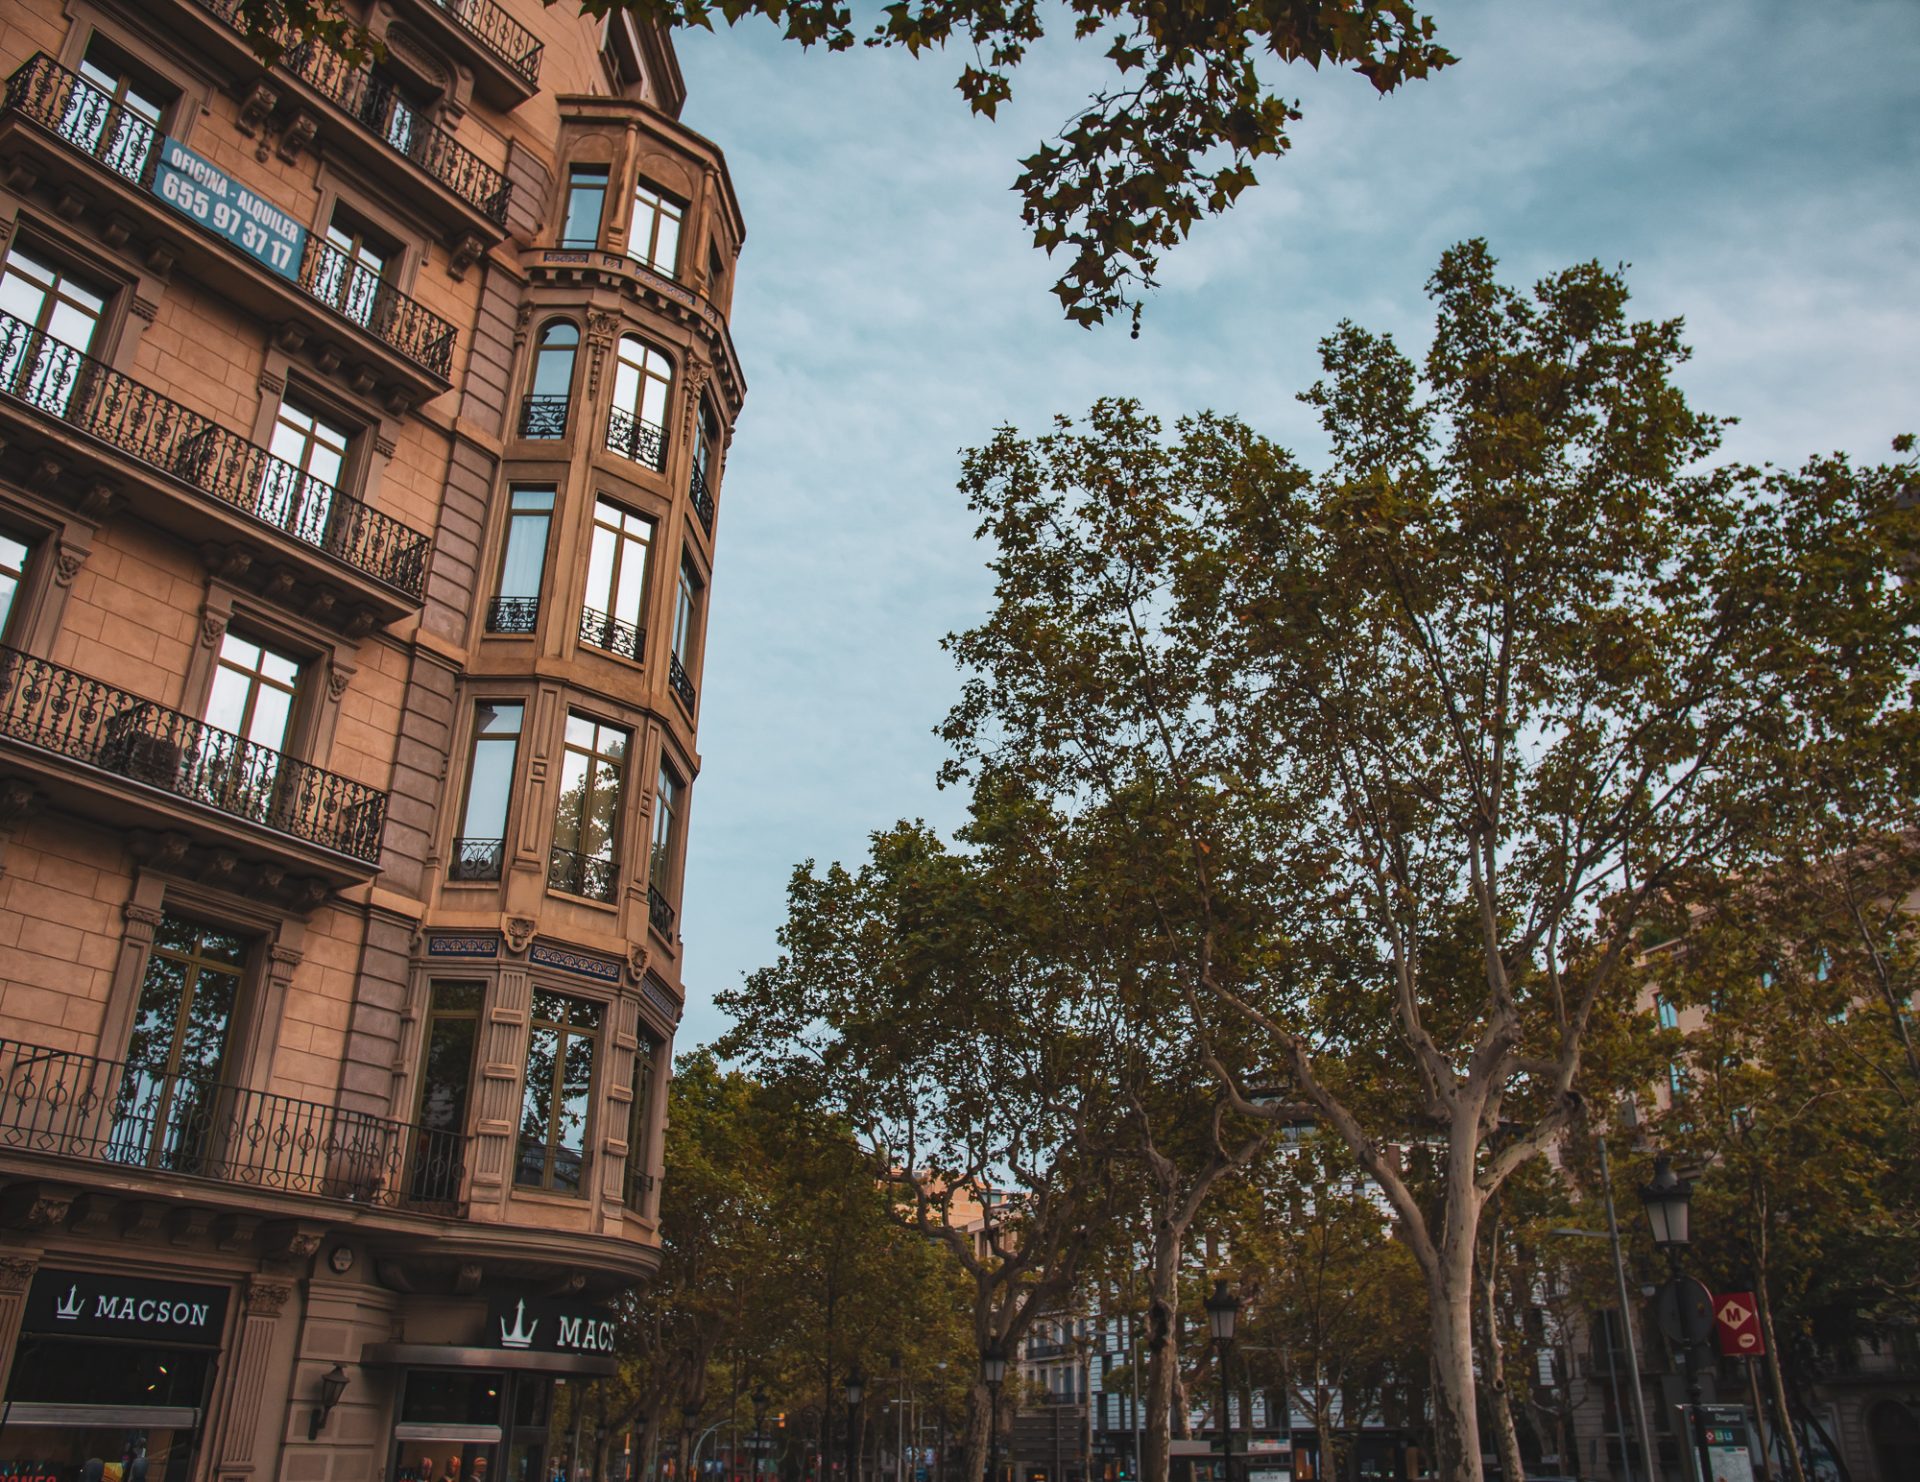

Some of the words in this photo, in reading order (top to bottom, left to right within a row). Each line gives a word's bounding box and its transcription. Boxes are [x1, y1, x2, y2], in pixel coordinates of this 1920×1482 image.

[162, 172, 210, 219] 655
[212, 202, 242, 236] 97
[242, 220, 269, 255] 37
[270, 240, 293, 270] 17
[171, 148, 228, 198] OFICINA
[237, 190, 299, 244] ALQUILER
[94, 1295, 210, 1327] MACSON
[1725, 1308, 1742, 1322] M
